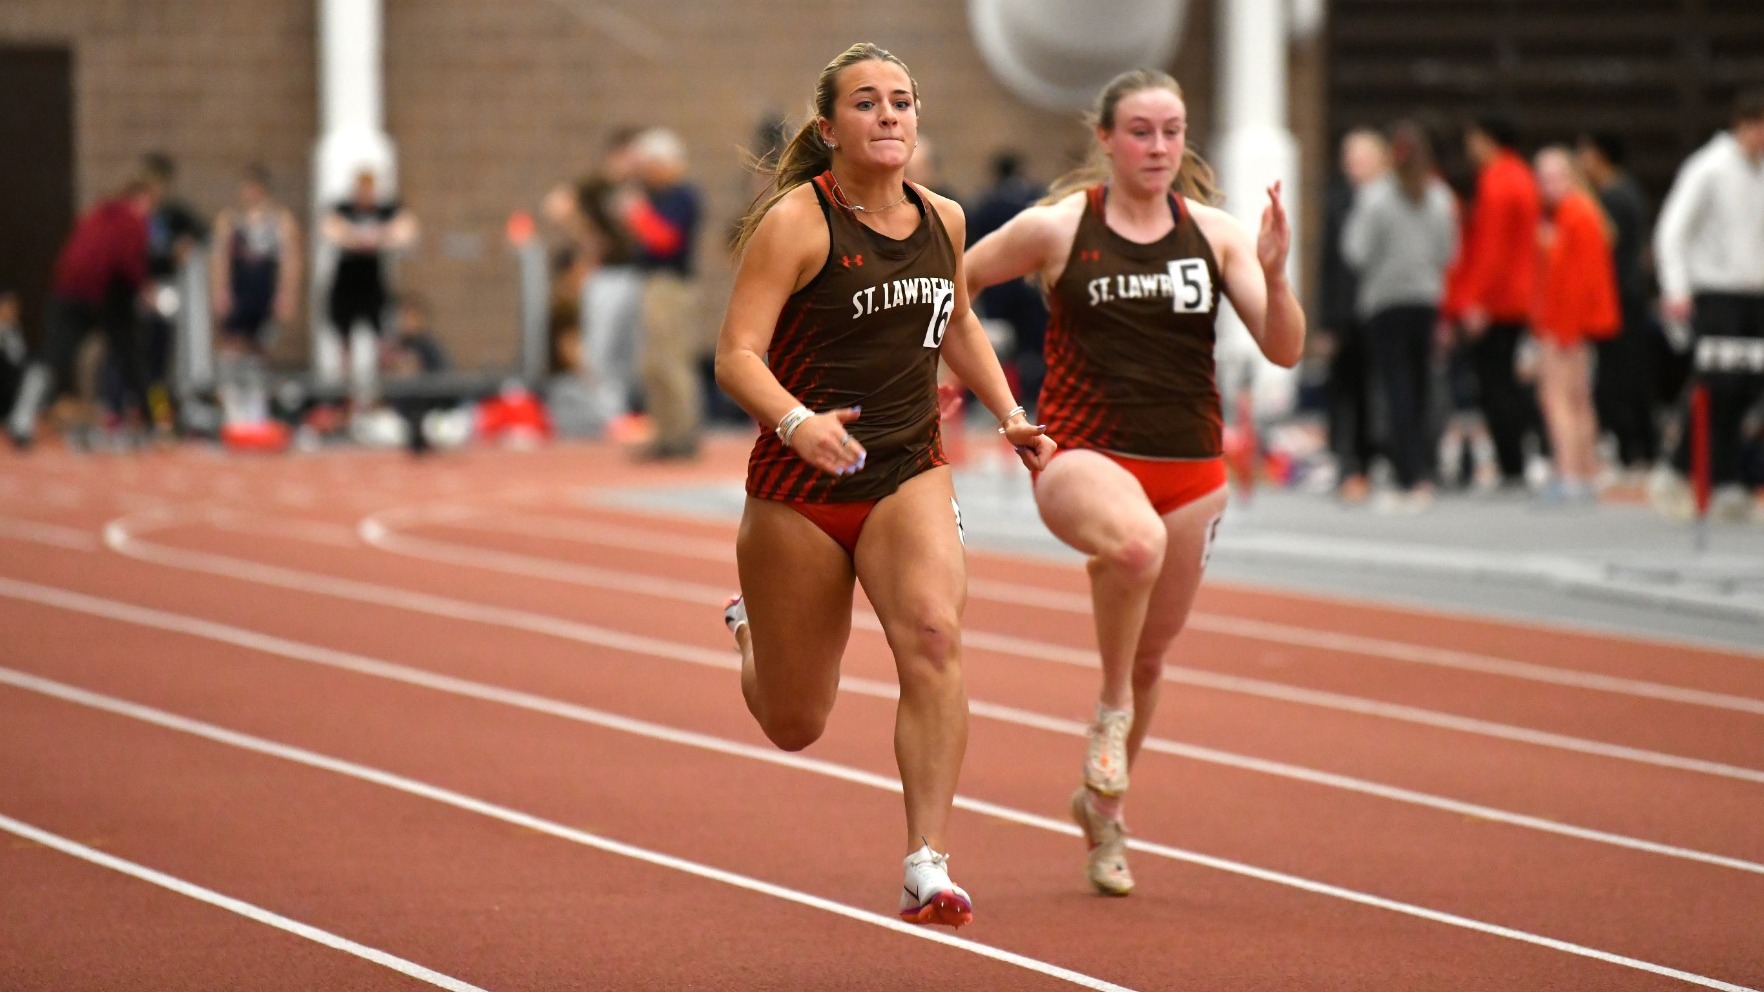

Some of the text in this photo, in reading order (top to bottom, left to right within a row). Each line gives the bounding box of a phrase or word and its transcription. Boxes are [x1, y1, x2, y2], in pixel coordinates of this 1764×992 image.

[853, 286, 879, 319] ST.
[1088, 273, 1174, 306] ST. LAWR
[1180, 263, 1201, 309] 5
[933, 292, 952, 346] 6
